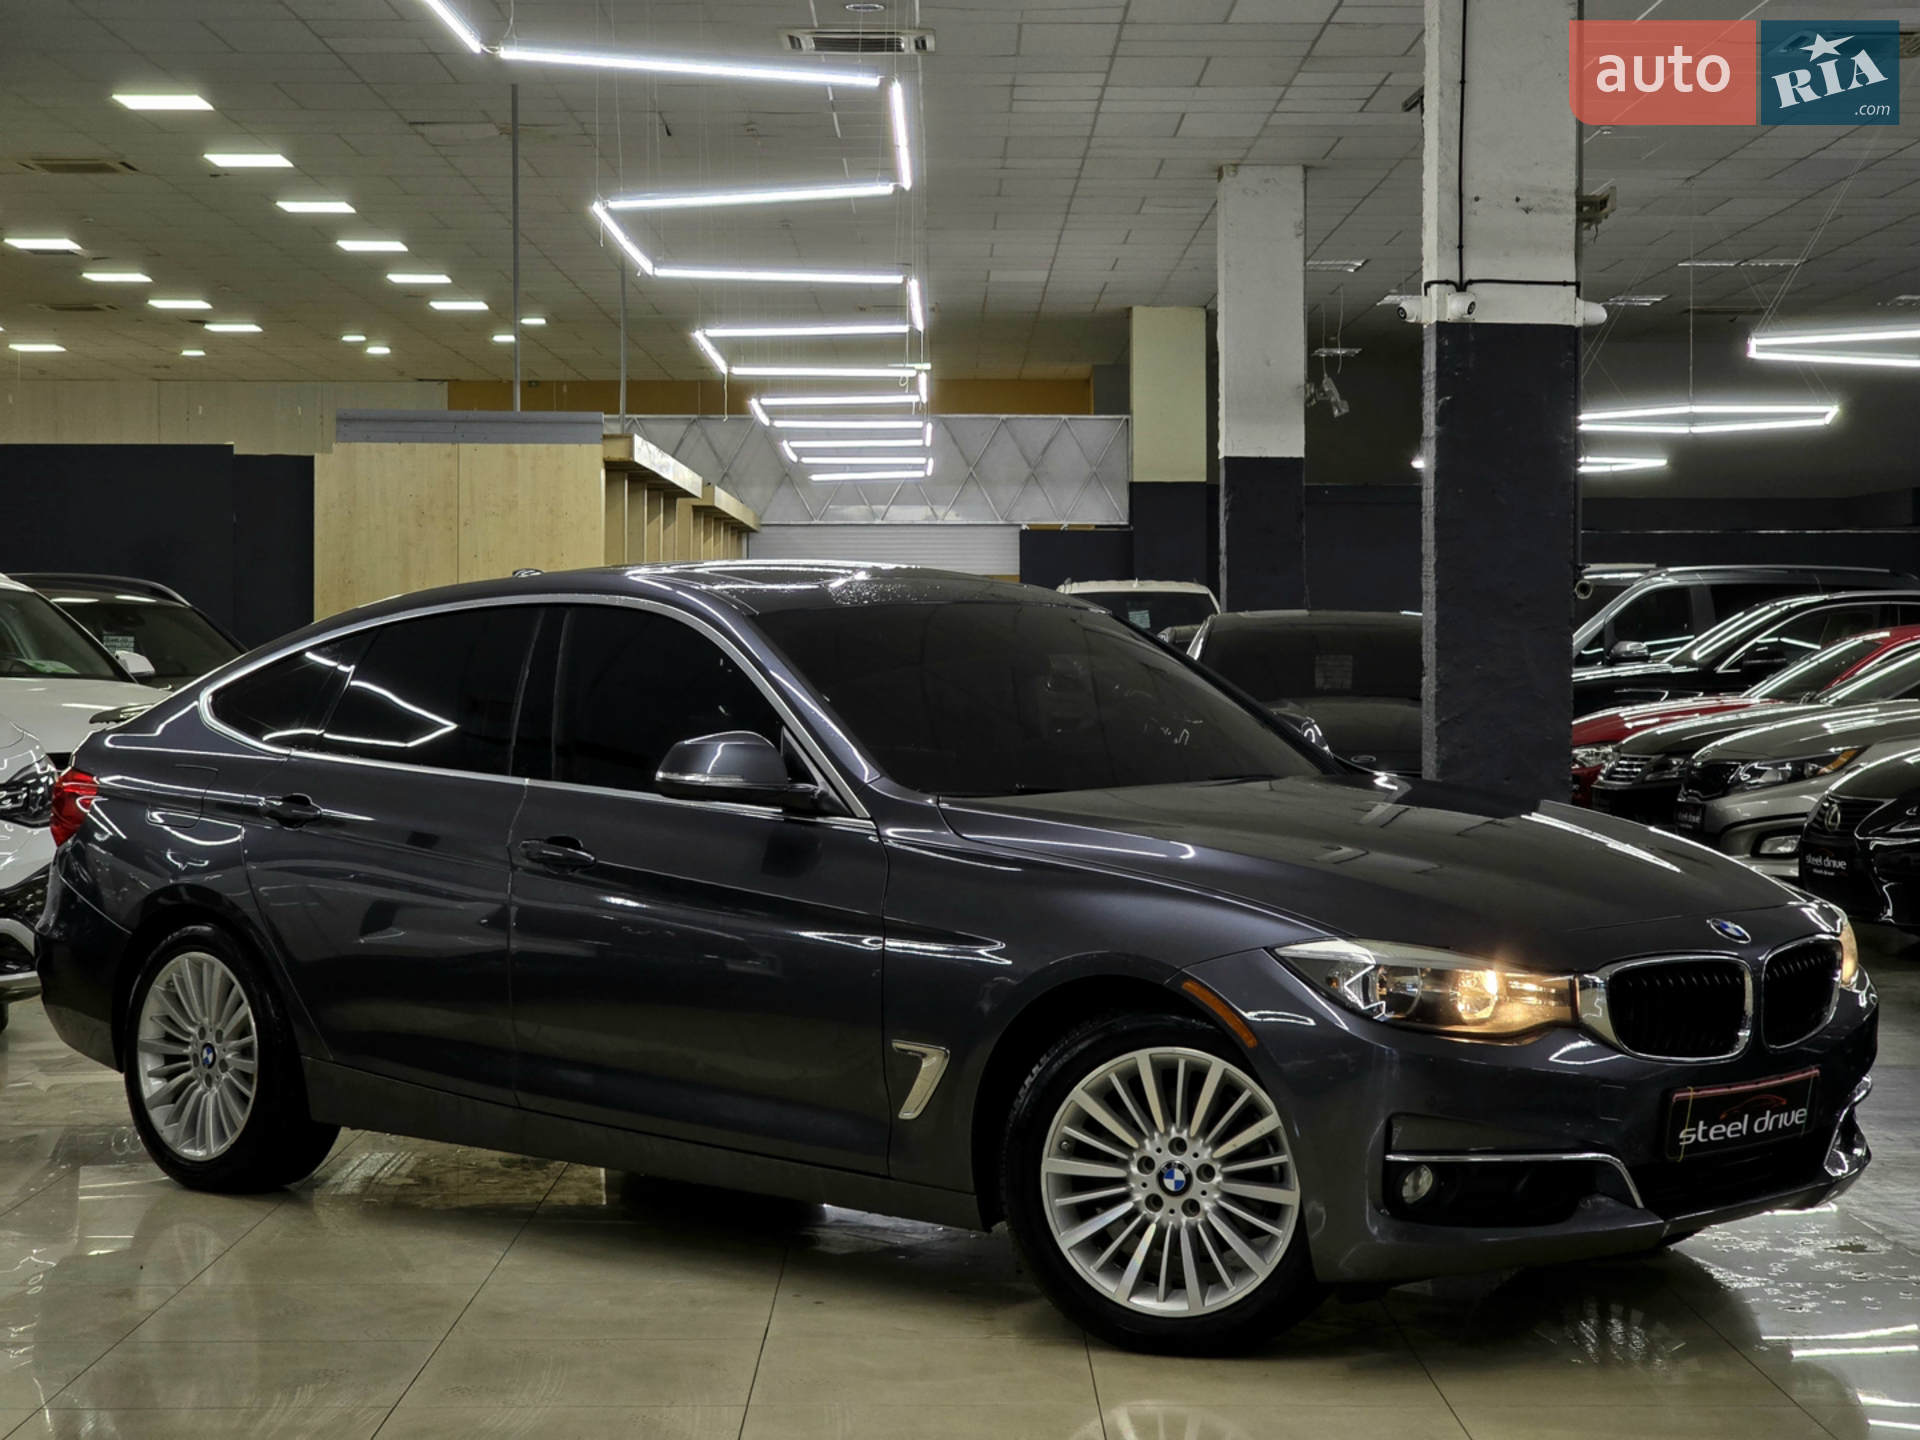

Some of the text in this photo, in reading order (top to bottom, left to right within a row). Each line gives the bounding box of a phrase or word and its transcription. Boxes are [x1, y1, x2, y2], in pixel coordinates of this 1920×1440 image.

[1823, 856, 1847, 870] drive
[1679, 1107, 1808, 1146] steel drive
